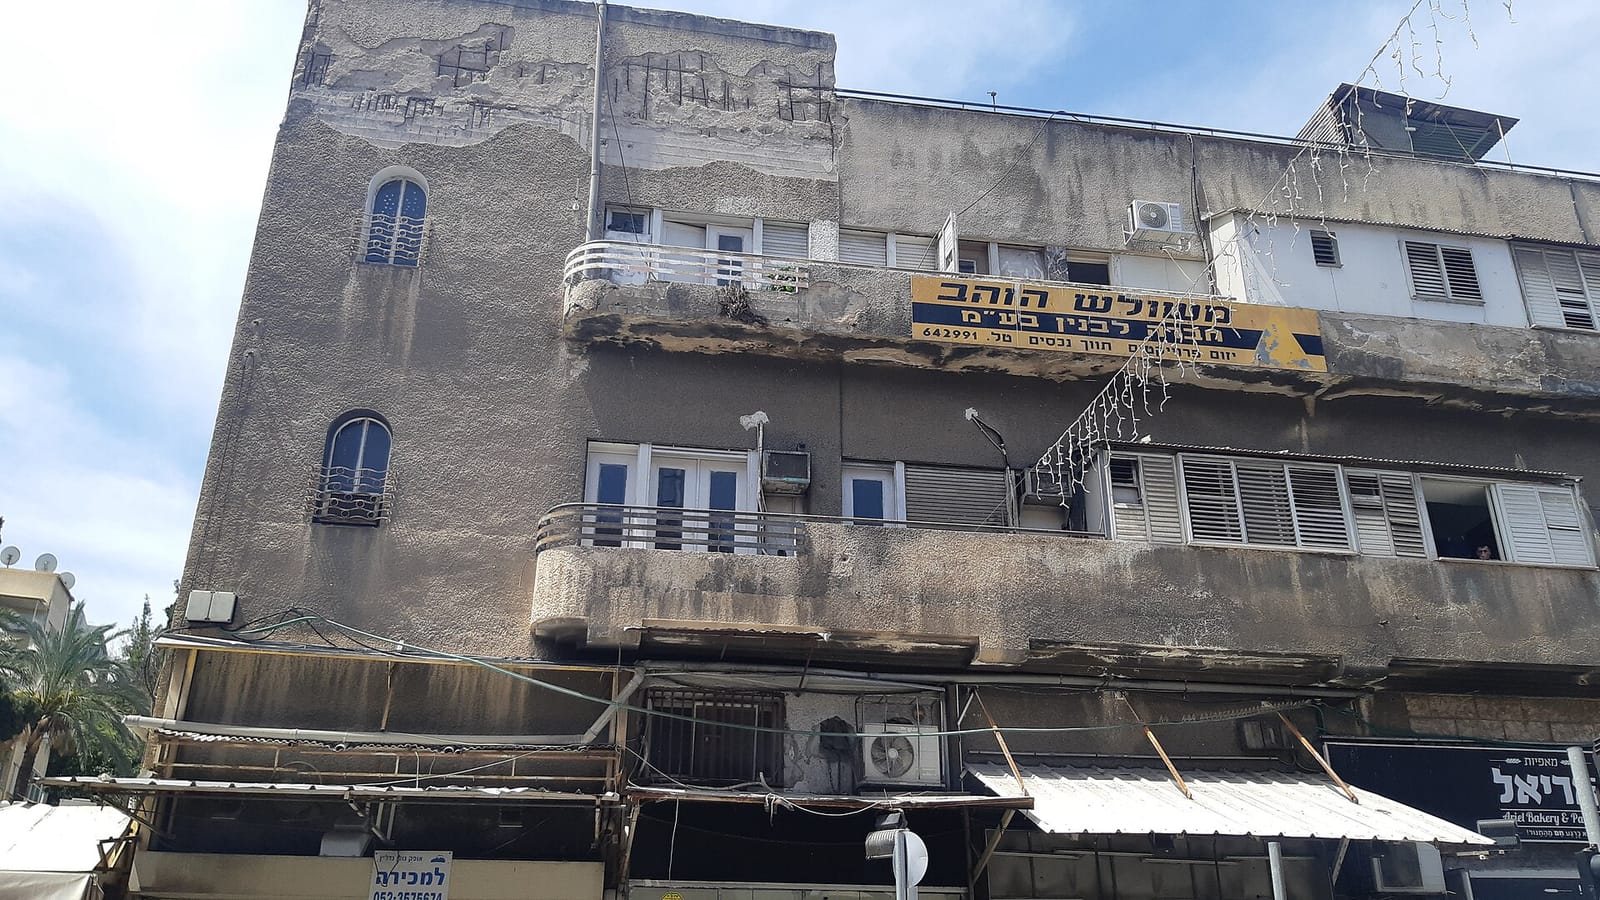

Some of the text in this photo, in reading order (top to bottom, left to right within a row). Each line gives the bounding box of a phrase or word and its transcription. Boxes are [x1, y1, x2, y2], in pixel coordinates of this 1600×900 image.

[937, 282, 1230, 324] משולש הזהב
[1055, 316, 1131, 335] לבנין
[922, 327, 977, 340] 642991
[1146, 324, 1224, 343] חברה
[1029, 335, 1072, 348] נכסים
[1080, 339, 1112, 351] תווך
[1524, 757, 1558, 767] מאפיות
[1502, 811, 1525, 823] Ariel
[1526, 812, 1560, 826] Bakery
[1561, 812, 1570, 824] &
[375, 867, 446, 886] למכירה
